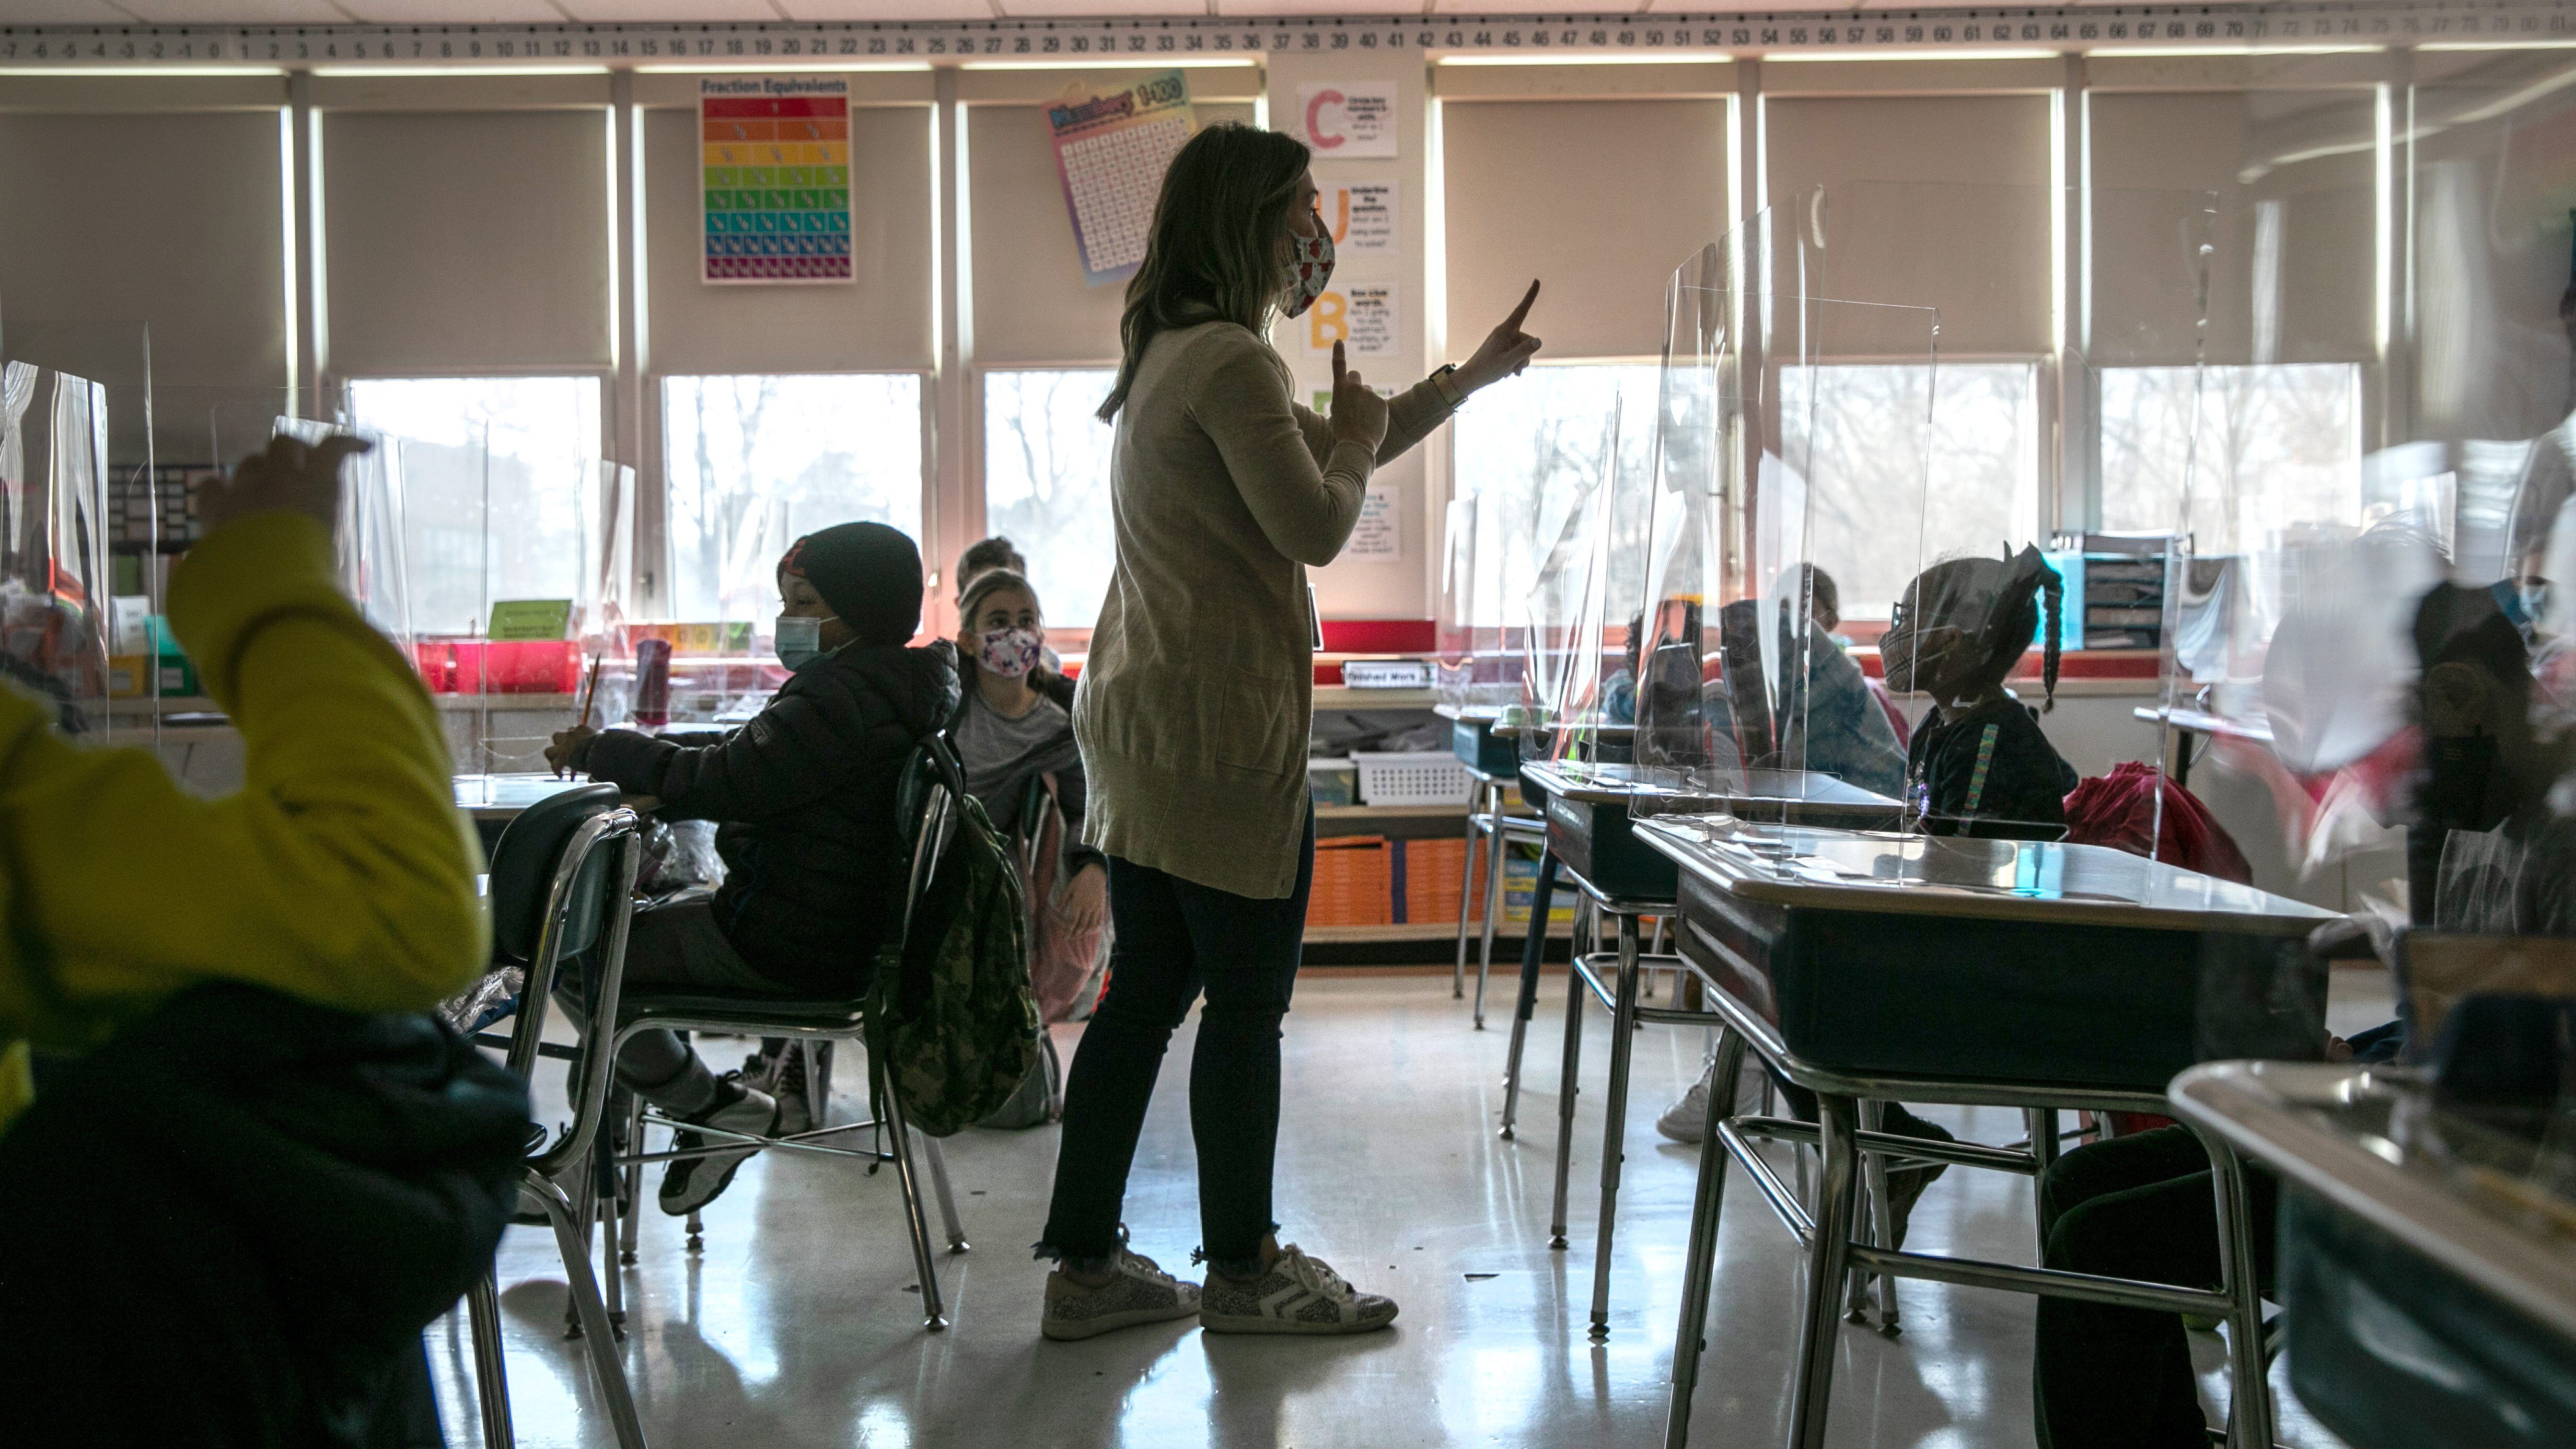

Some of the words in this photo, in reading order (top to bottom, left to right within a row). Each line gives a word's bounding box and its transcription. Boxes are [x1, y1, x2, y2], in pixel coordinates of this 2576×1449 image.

[701, 78, 760, 93] Fraction
[763, 78, 848, 96] Equivalents
[1049, 90, 1134, 129] Numbers
[1136, 76, 1183, 106] 1-100
[1306, 89, 1345, 149] C
[1310, 291, 1349, 349] B
[1348, 672, 1386, 681] Finished
[1389, 672, 1416, 680] Work
